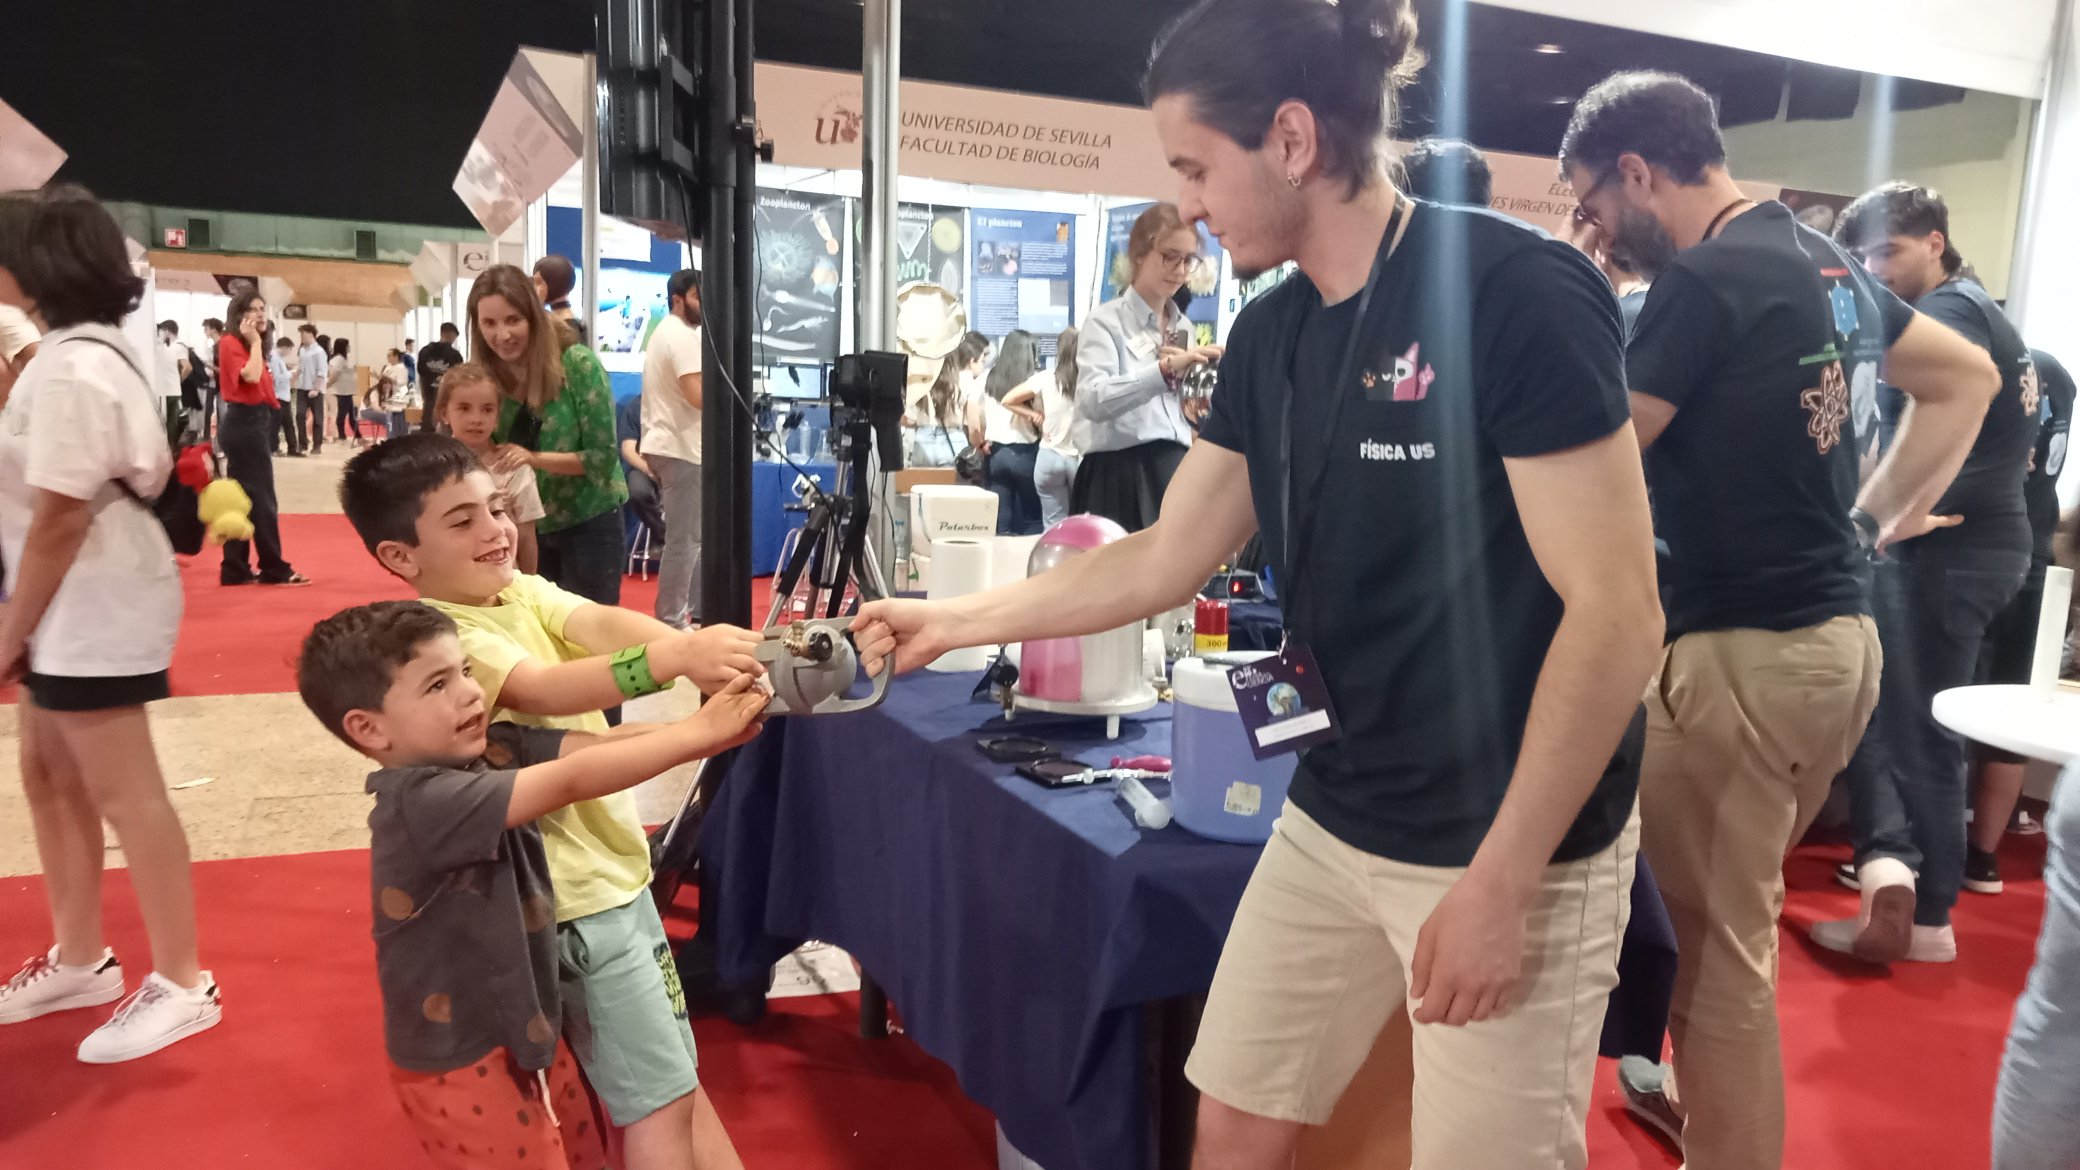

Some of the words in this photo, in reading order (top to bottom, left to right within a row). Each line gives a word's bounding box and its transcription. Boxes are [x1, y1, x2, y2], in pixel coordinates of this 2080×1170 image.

[901, 111, 1019, 138] UNIVERSIDAD
[1022, 125, 1046, 141] DE
[1049, 128, 1111, 149] SEVILLA
[900, 135, 993, 158] FACULTAD
[996, 145, 1020, 162] DE
[1022, 148, 1099, 170] BIOLOGÍA
[760, 196, 811, 211] Zooplancton
[1509, 198, 1553, 214] VIRGEN
[1360, 437, 1406, 460] FÍSICA
[1409, 442, 1435, 460] US
